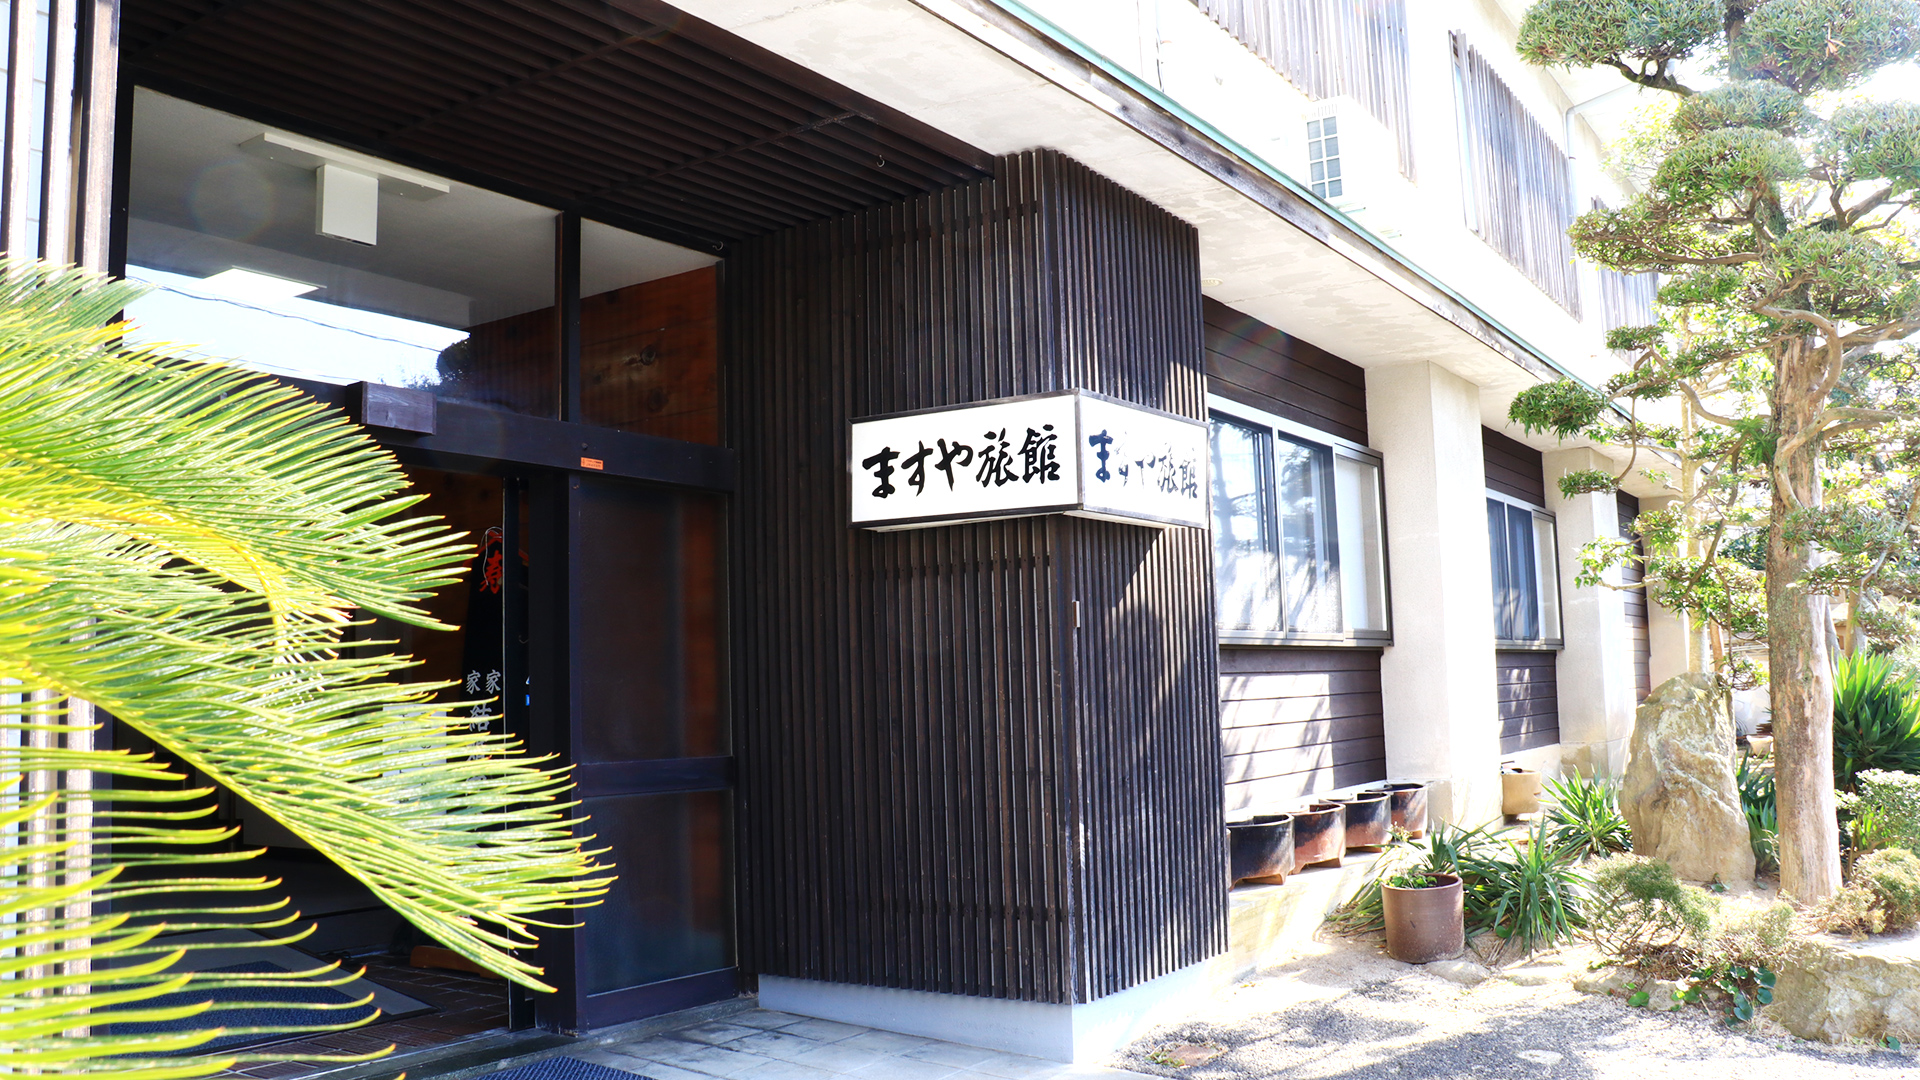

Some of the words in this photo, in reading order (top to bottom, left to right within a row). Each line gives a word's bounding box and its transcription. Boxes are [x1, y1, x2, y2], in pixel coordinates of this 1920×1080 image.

[862, 424, 1061, 498] ますや旅館
